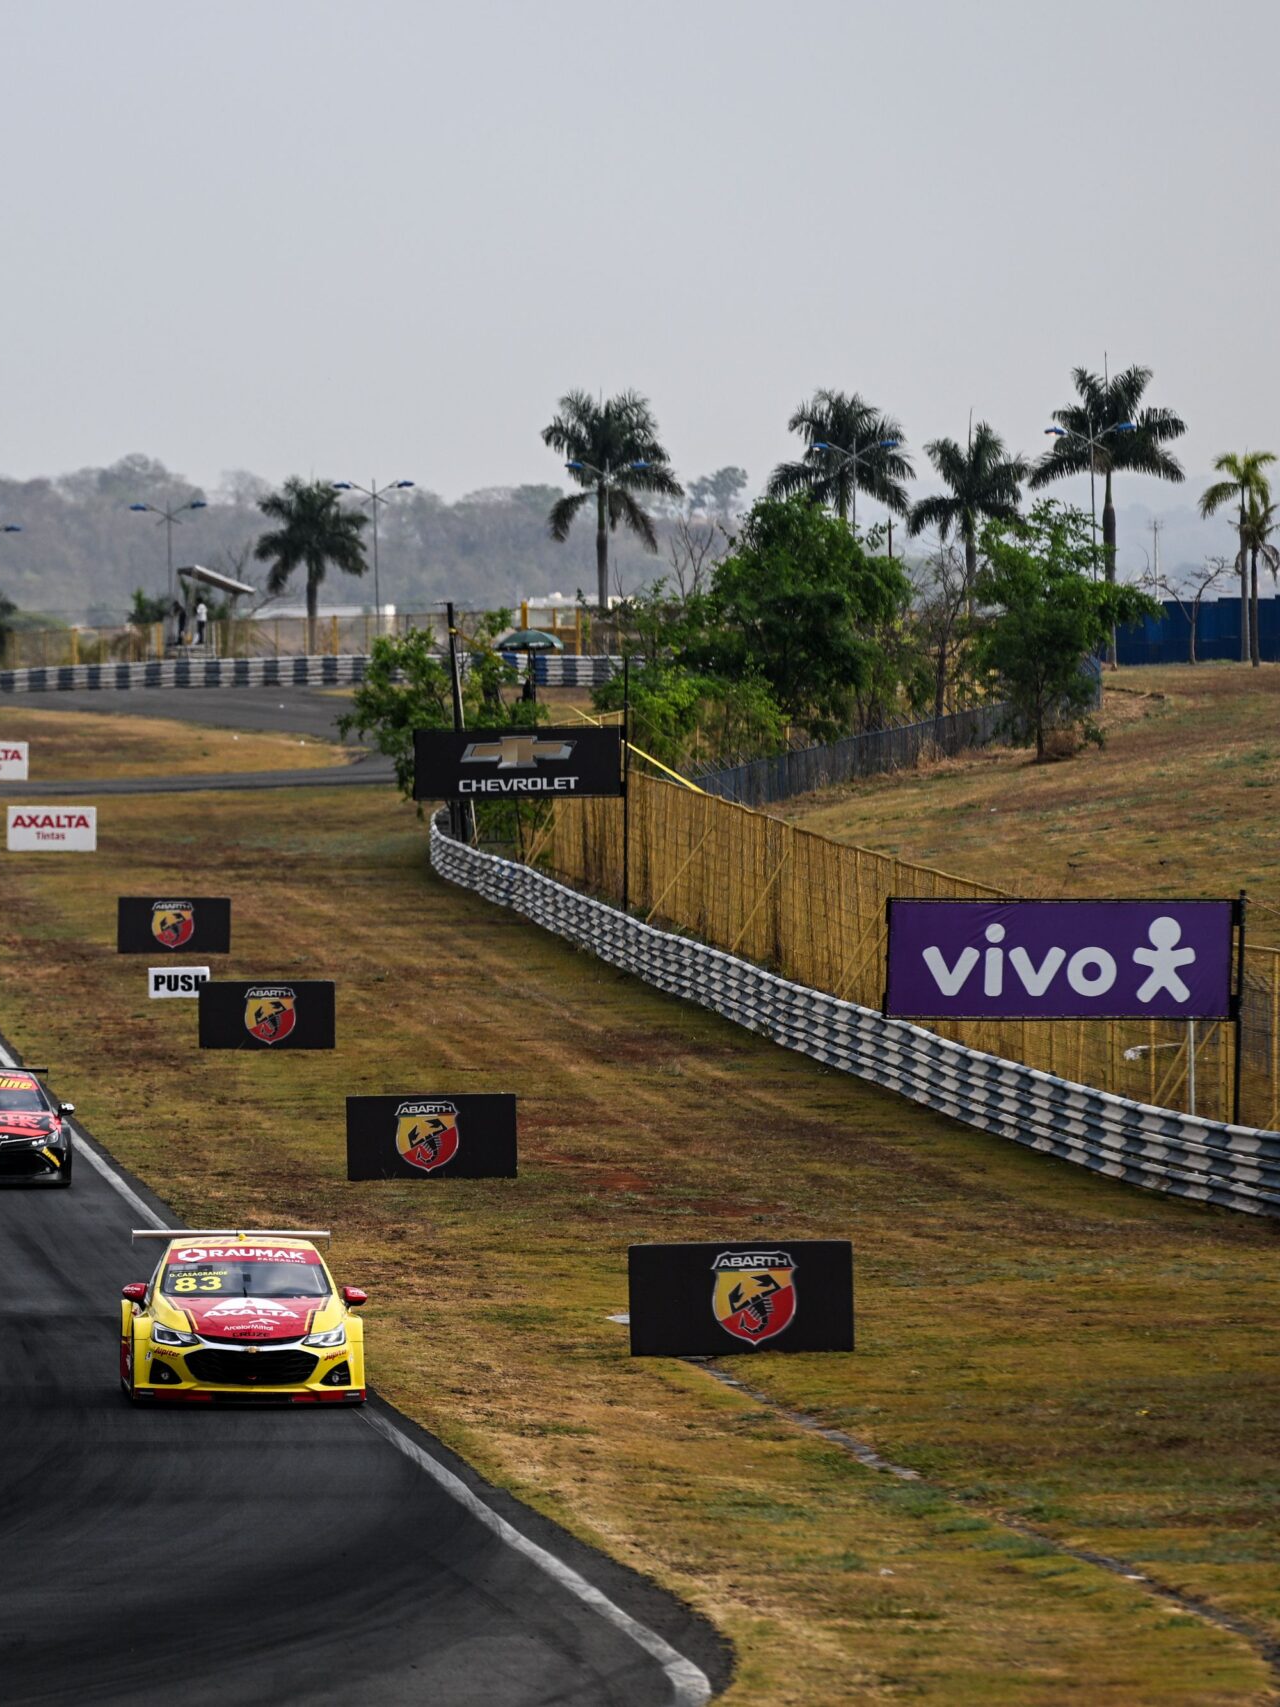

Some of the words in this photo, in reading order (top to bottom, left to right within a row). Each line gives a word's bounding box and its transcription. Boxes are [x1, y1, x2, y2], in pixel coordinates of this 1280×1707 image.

[458, 776, 579, 793] CHEVROLET
[12, 815, 90, 828] AXALTA
[35, 831, 66, 841] Tintas
[922, 923, 1117, 997] vivo
[248, 990, 291, 998] ABARTH
[400, 1105, 452, 1113] ABARTH
[209, 1248, 305, 1260] RAUMAK
[719, 1256, 787, 1267] ABARTH
[174, 1277, 222, 1291] 83
[202, 1309, 299, 1318] AXALTA
